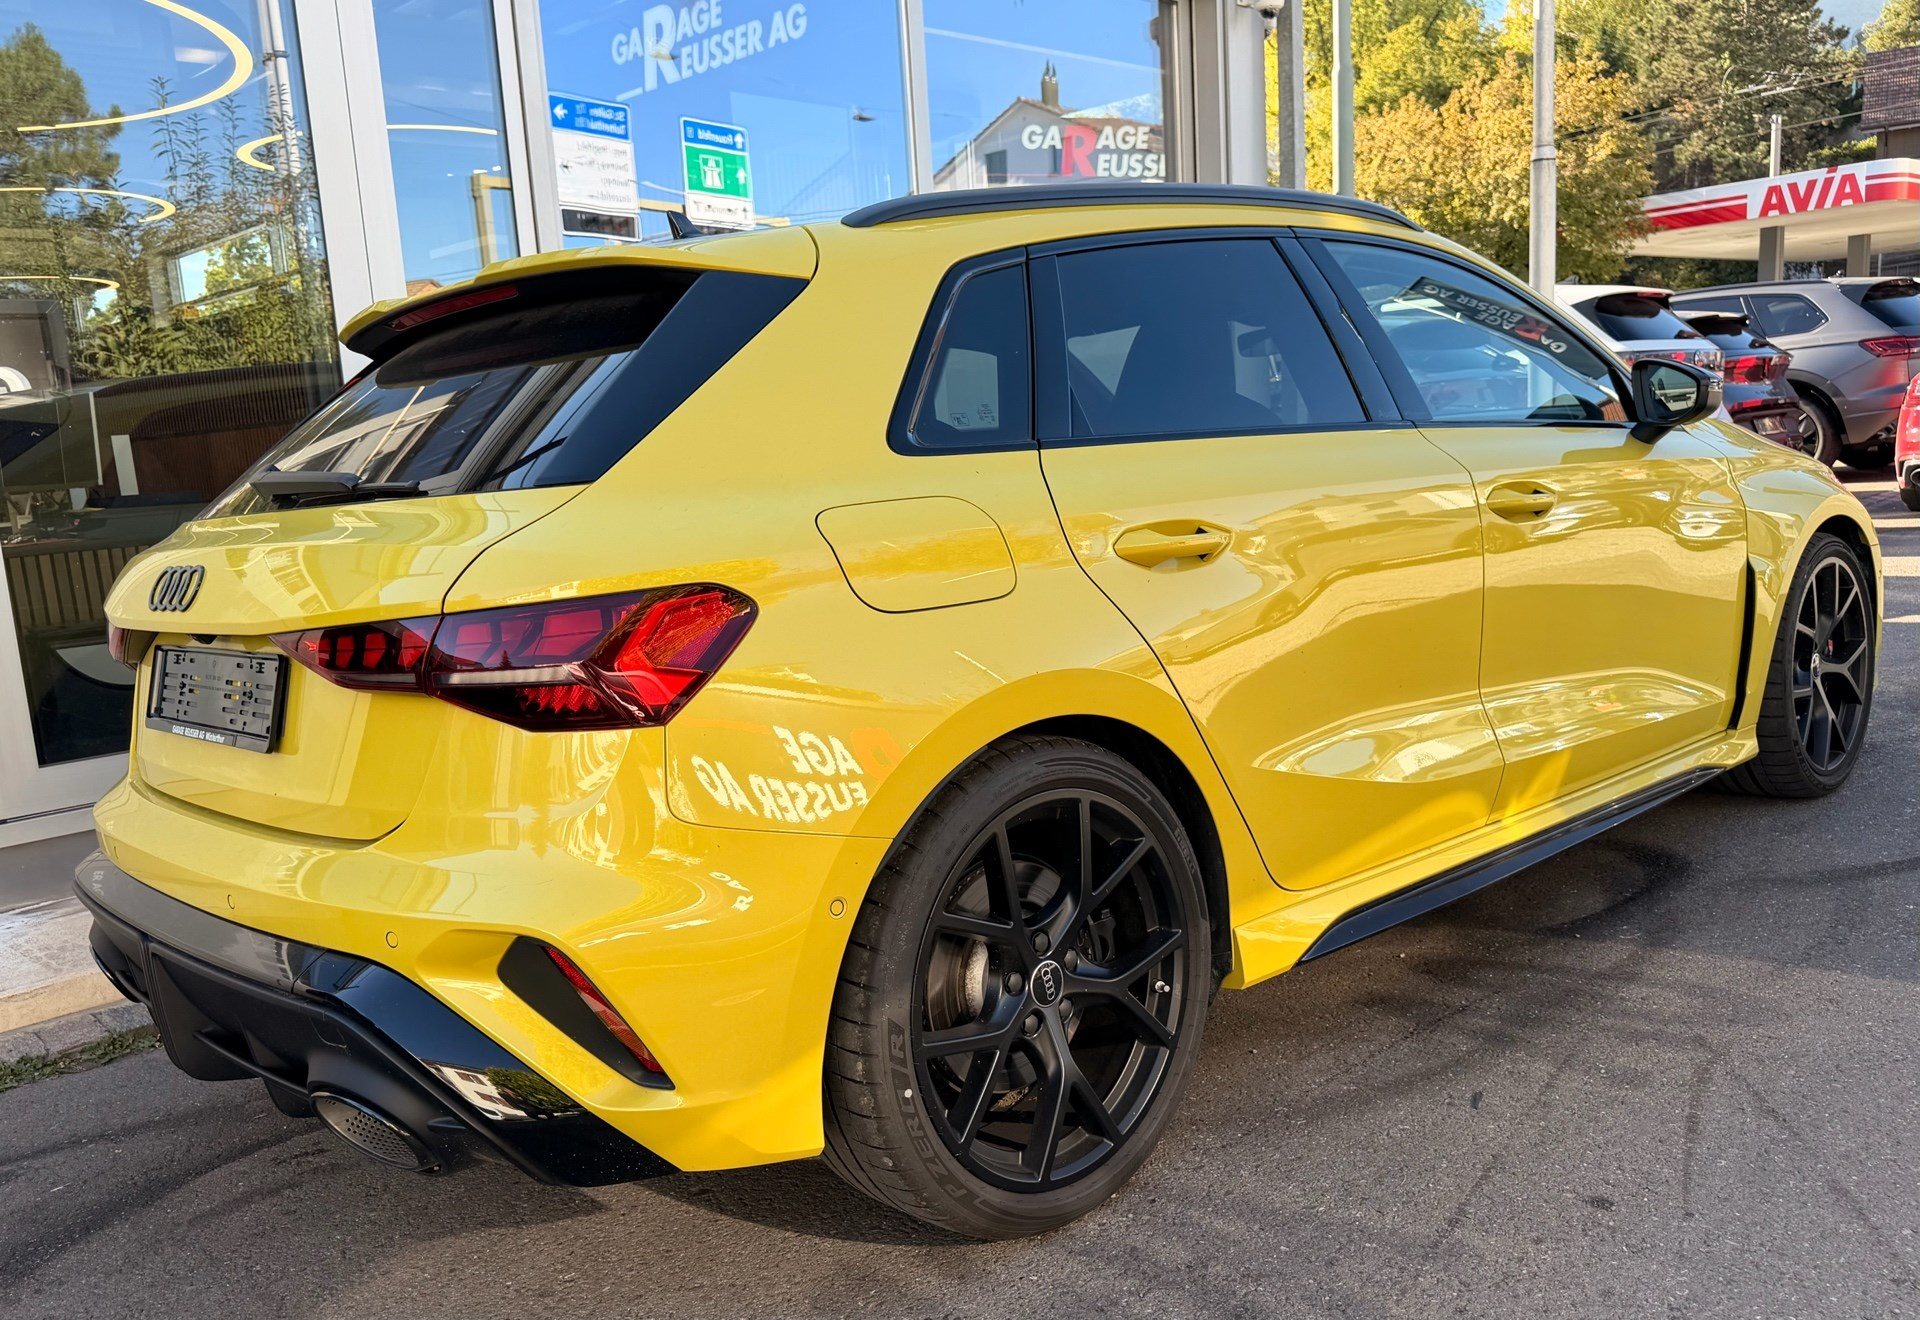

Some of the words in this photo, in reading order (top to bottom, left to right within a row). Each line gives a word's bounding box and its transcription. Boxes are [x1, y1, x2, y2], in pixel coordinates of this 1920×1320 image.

[611, 0, 722, 88] GARAGE
[768, 3, 807, 48] AG
[1021, 124, 1151, 167] GARAGE
[1759, 166, 1865, 219] AVIA
